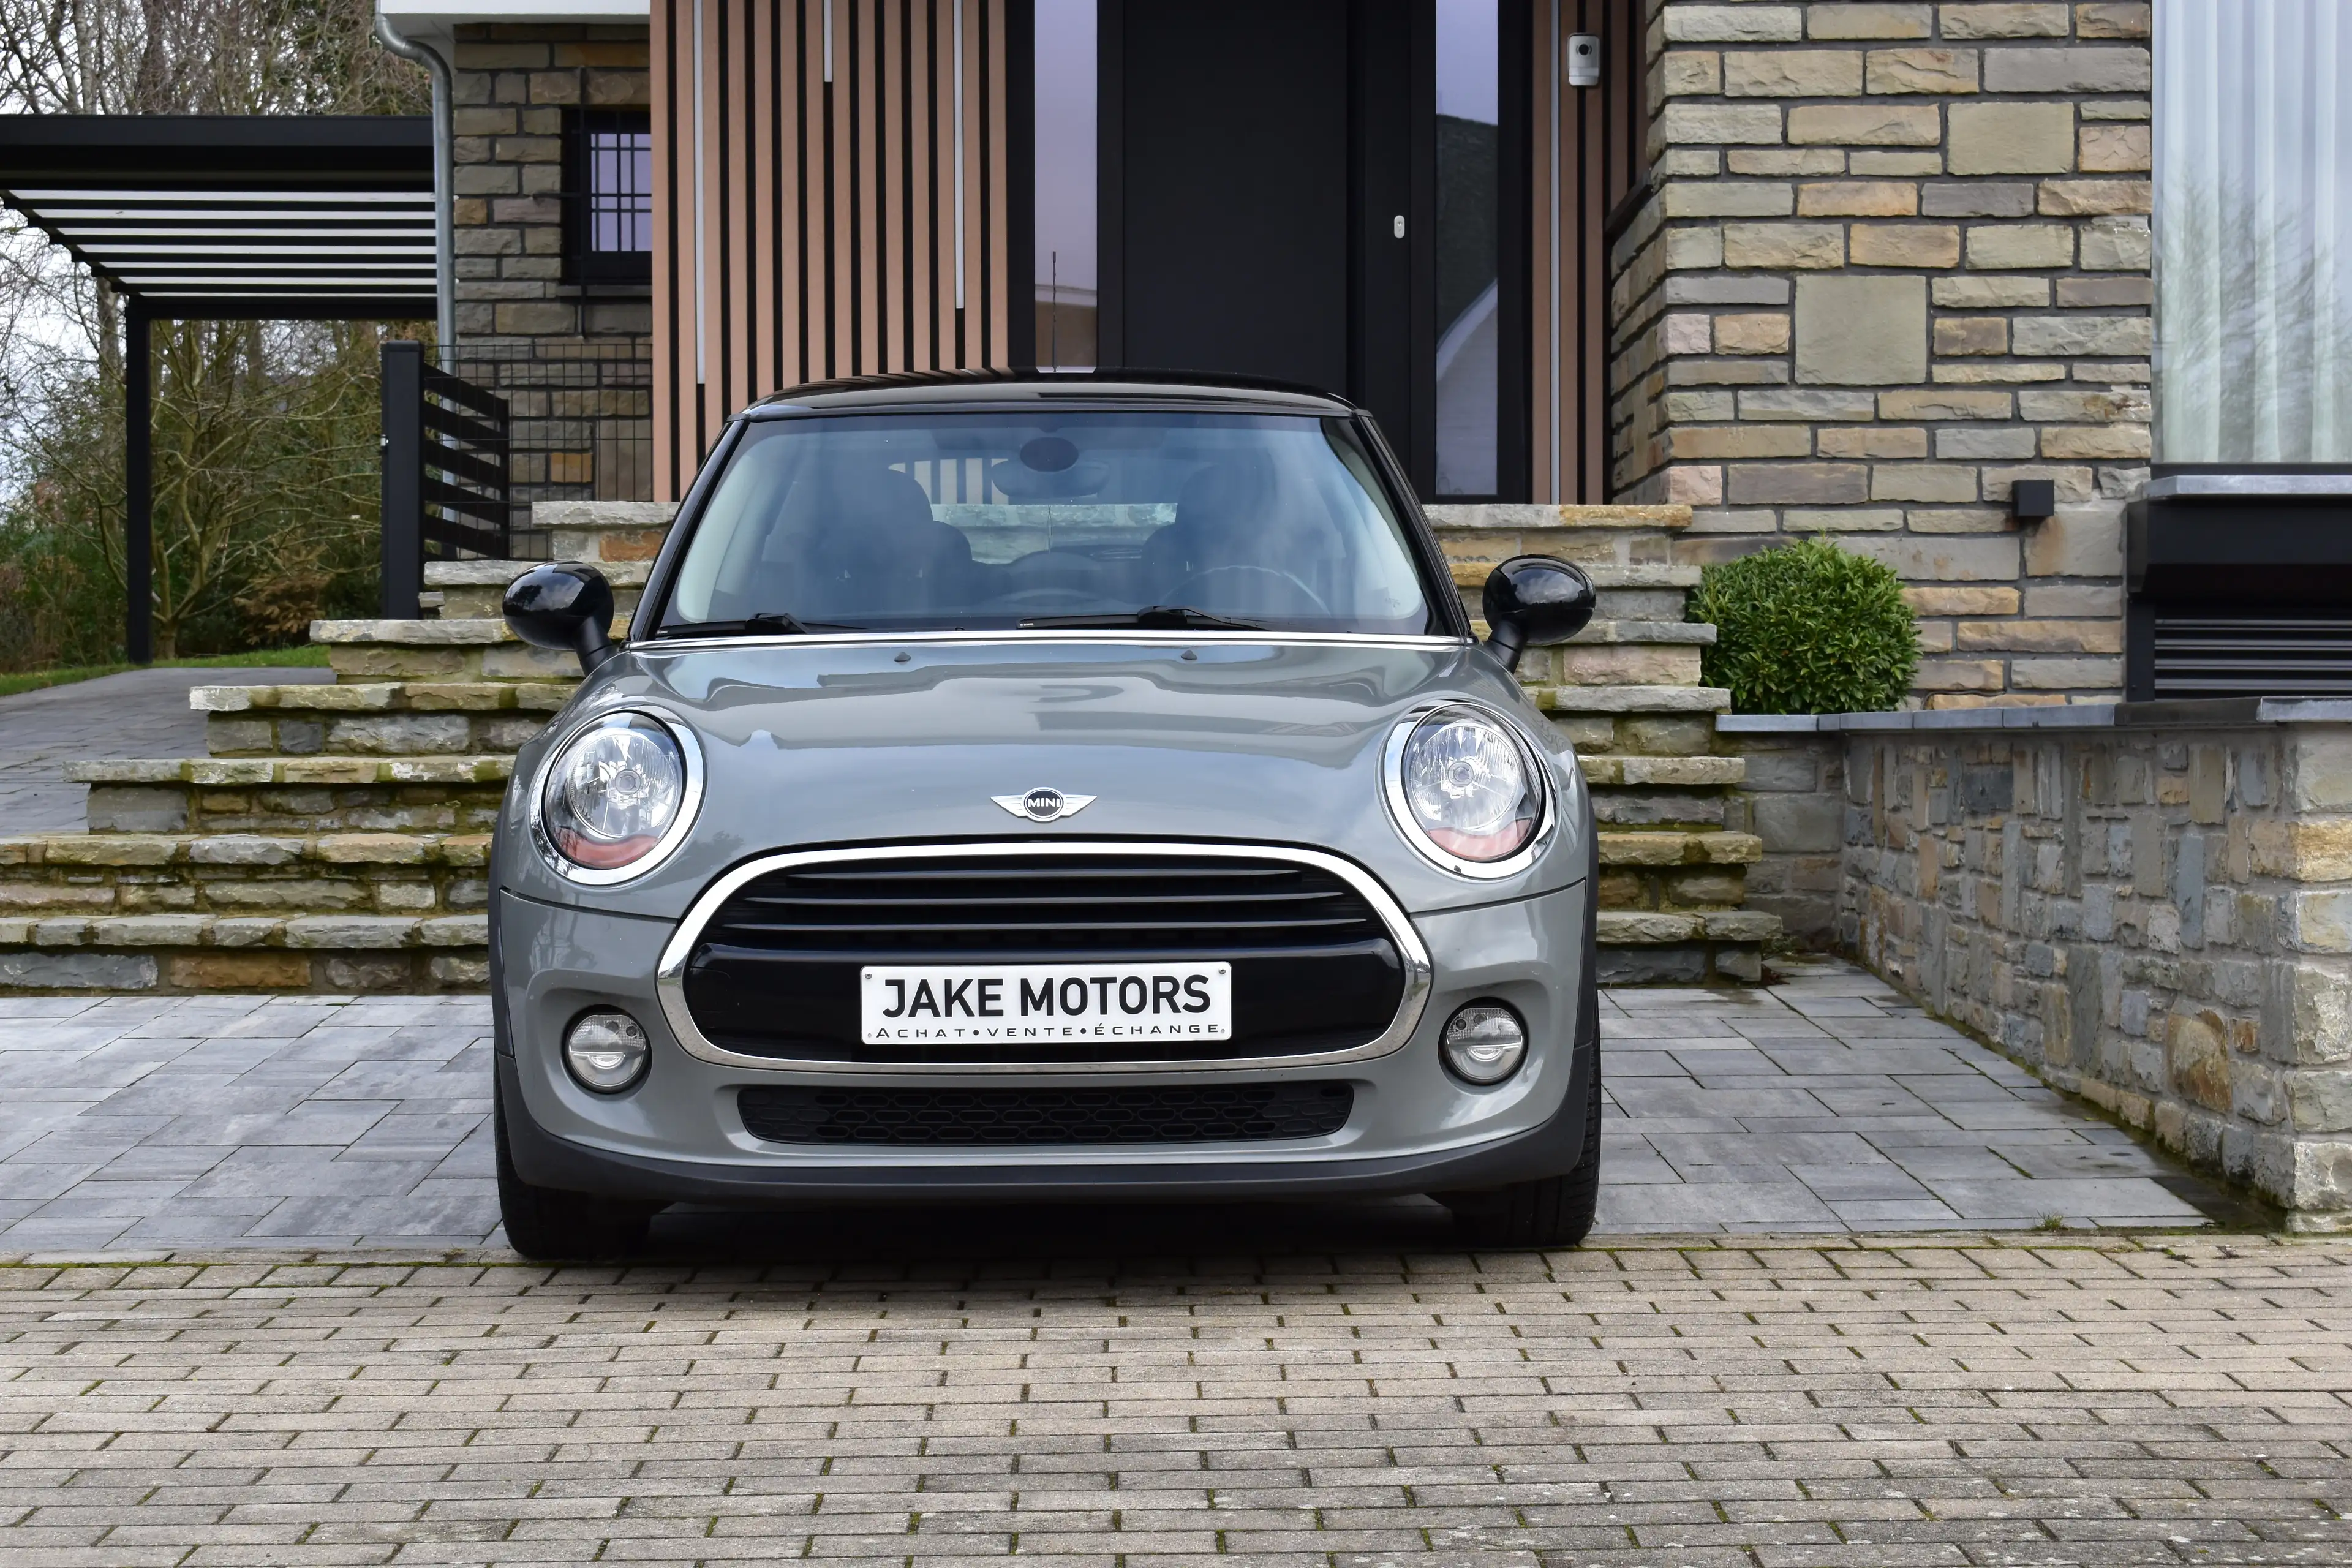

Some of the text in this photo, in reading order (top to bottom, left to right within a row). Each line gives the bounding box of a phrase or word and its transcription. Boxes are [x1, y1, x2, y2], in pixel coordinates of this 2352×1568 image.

[1027, 797, 1060, 808] MINI
[882, 974, 1211, 1018] JAKE MOTORS
